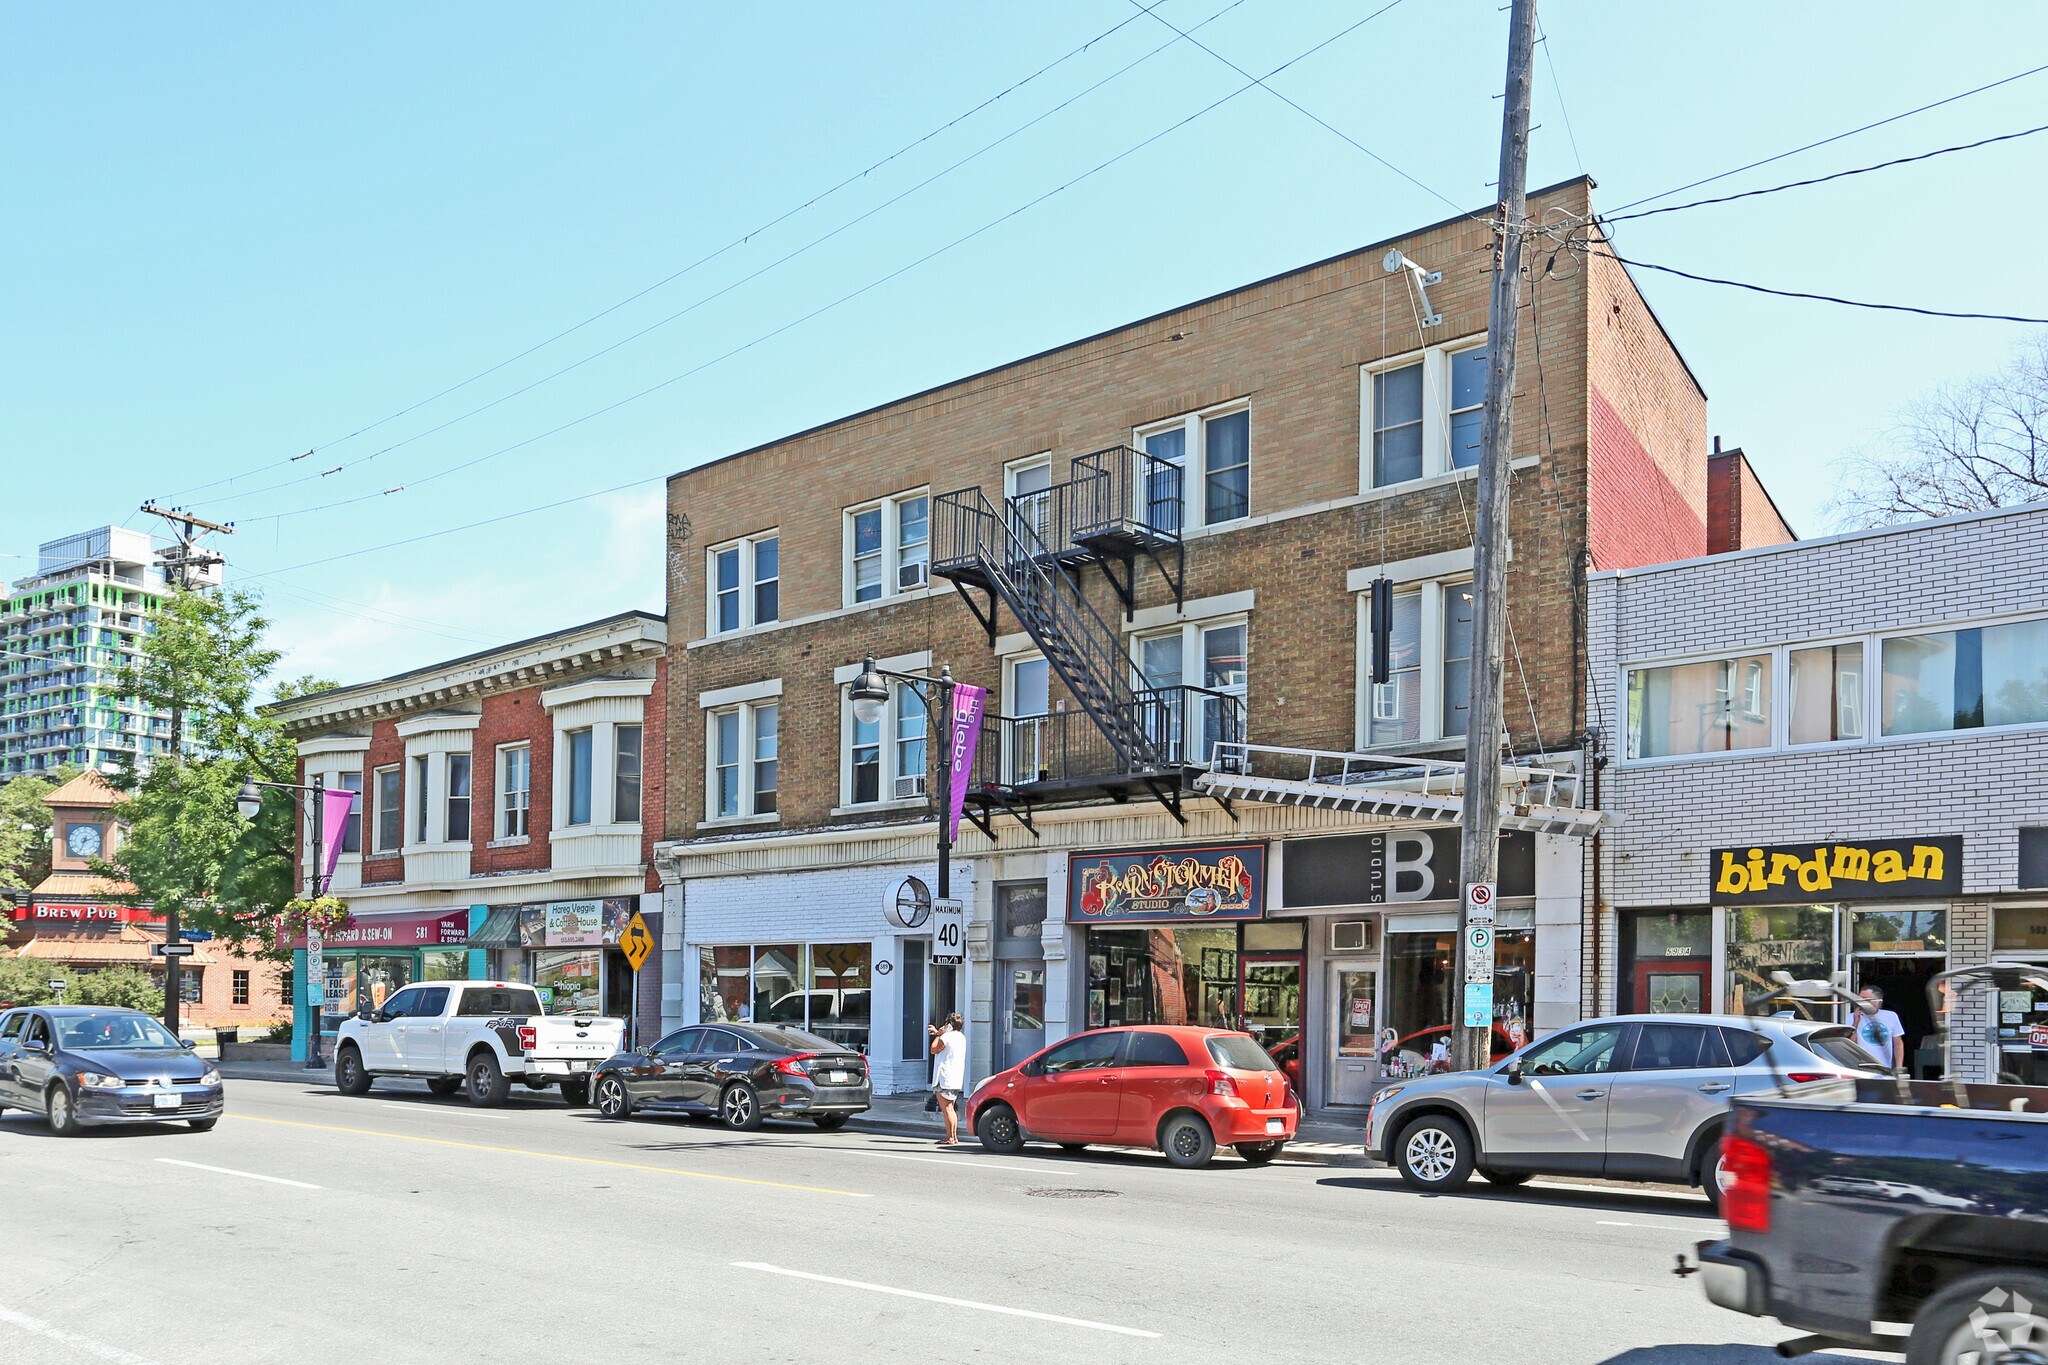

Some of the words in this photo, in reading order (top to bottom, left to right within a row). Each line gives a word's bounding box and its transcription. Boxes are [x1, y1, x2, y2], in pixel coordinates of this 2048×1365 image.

[967, 697, 979, 724] the
[954, 709, 968, 773] glebe
[1370, 836, 1382, 903] STUDIO
[1386, 830, 1435, 902] B
[1715, 845, 1945, 894] birdman
[552, 904, 571, 915] Hareg
[571, 903, 595, 914] Veggie
[935, 904, 962, 916] MAXIMUM
[1131, 899, 1170, 910] STUDIO
[37, 905, 81, 920] BREW
[87, 905, 118, 920] PUB
[440, 920, 455, 929] YARN
[549, 917, 555, 928] &
[555, 917, 576, 927] Coffee
[576, 916, 598, 927] House
[415, 926, 428, 939] 581
[440, 928, 466, 937] FORWARD
[938, 923, 958, 947] 40
[1665, 946, 1692, 957] 593A
[937, 955, 960, 964] km/h
[325, 989, 349, 999] LEASE
